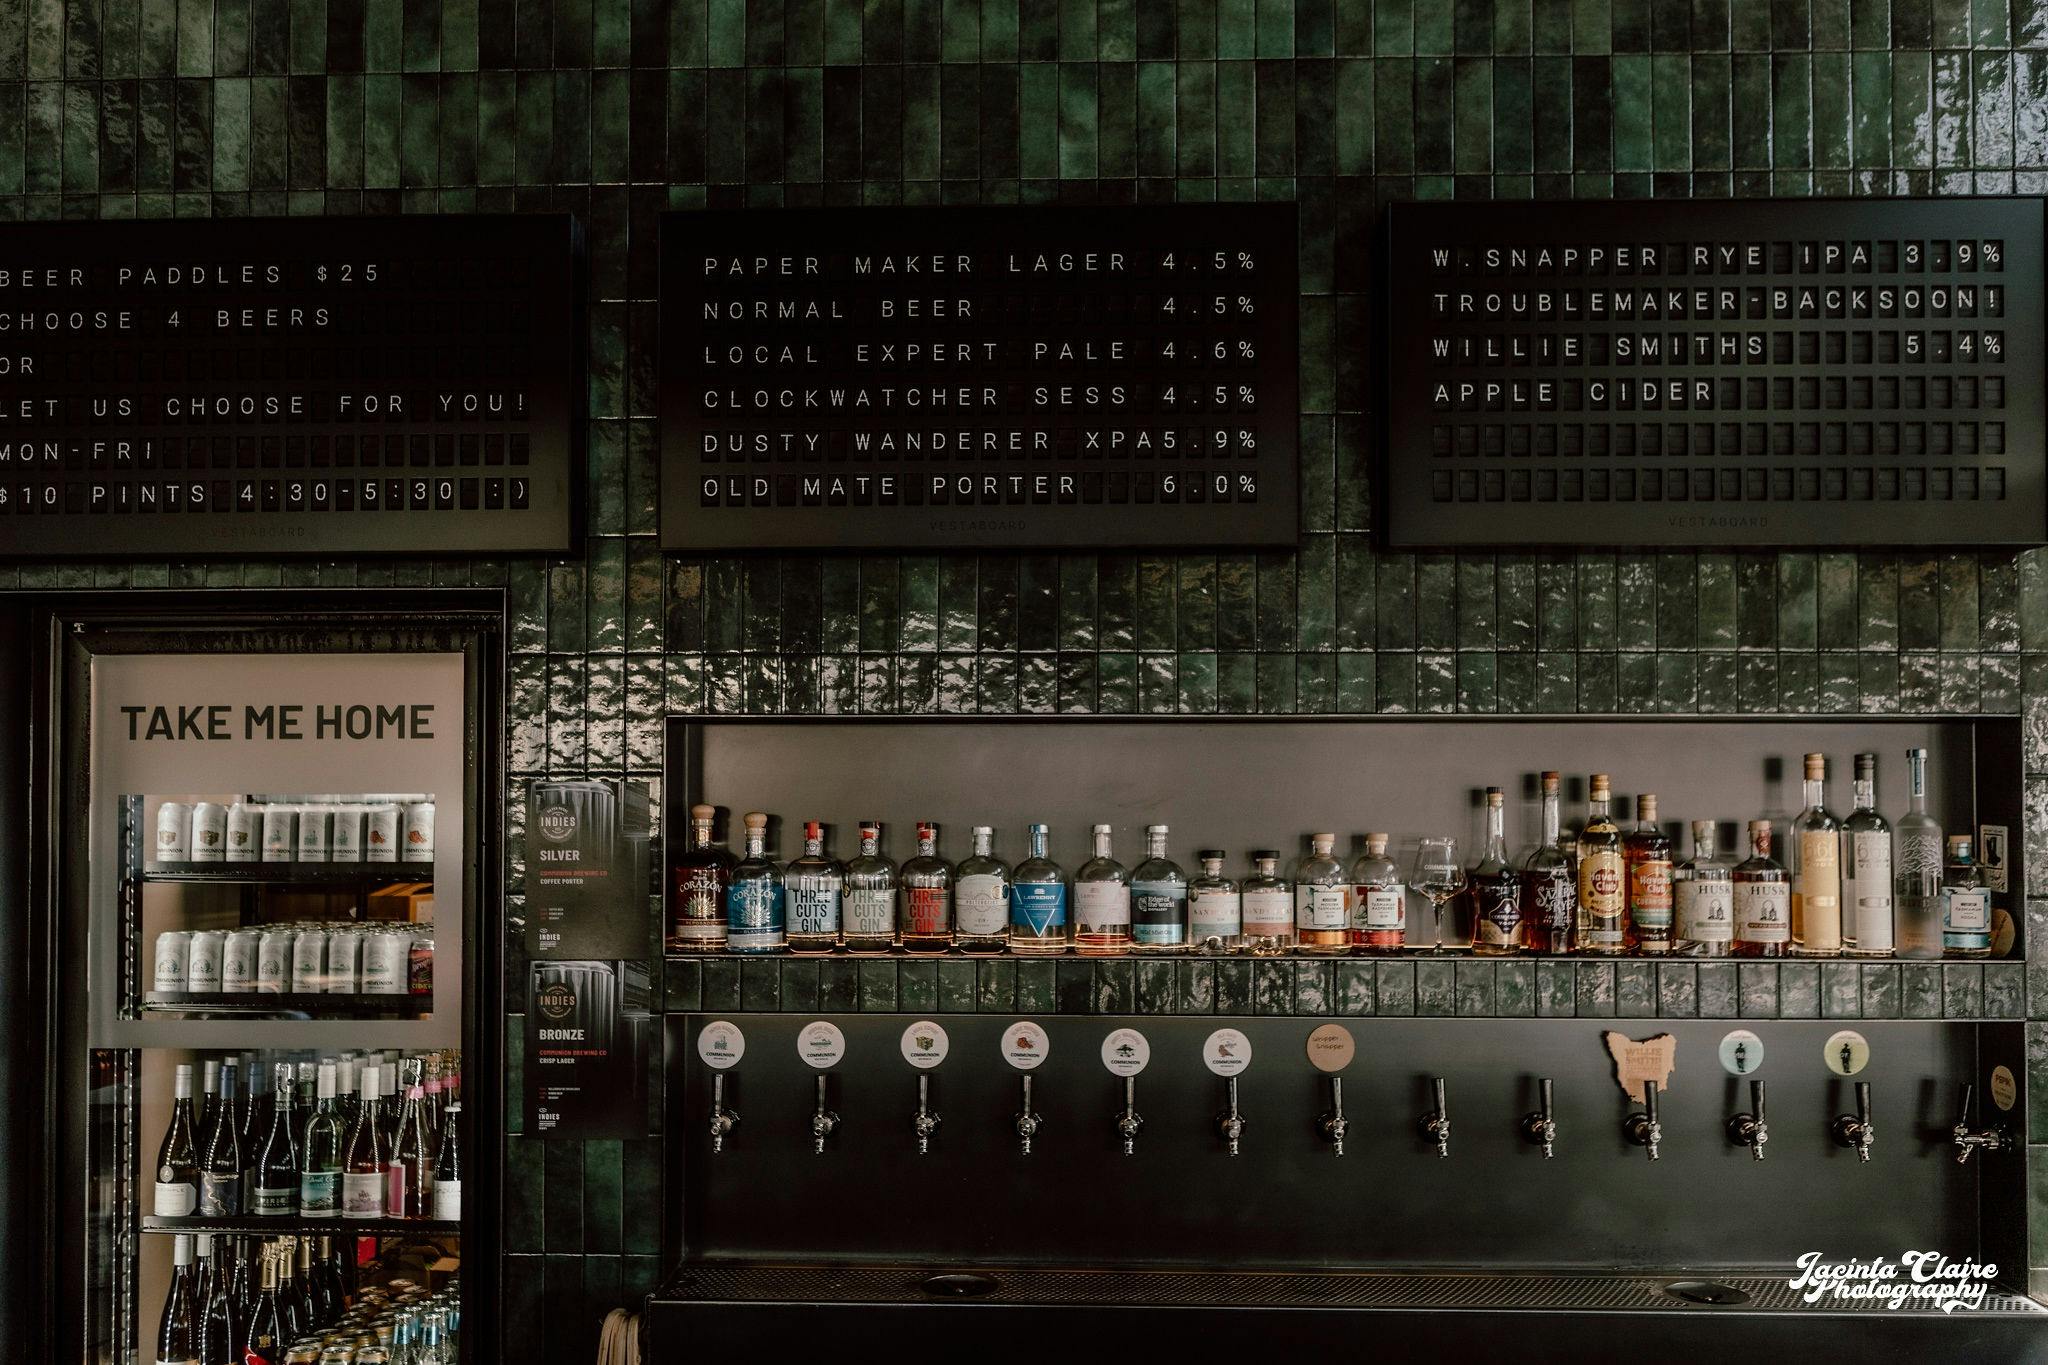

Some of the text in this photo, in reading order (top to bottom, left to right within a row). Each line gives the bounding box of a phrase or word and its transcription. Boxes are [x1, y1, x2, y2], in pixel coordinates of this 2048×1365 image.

[1694, 246, 1761, 265] RYE
[1804, 245, 1867, 265] IPA
[1906, 244, 2000, 264] 3.9%
[705, 251, 1254, 275] PAPER MAKER LAGER 4.5%
[0, 264, 377, 287] BEER PADDLES $25
[704, 296, 1254, 320] NORMAL BEER 4.5%
[1434, 289, 1995, 312] TROUBLEMAKER-BACKSOON!
[0, 308, 329, 331] CHOOSE 4 BEERS
[705, 340, 1255, 364] LOCAL EXPERT PALE 4.6%
[1433, 335, 2001, 357] WILLIE SMITHS 5.4%
[0, 356, 33, 374] OR
[704, 385, 1255, 408] CLOCKWATCHER SESS 4.5%
[1434, 381, 1710, 402] APPLE CIDER
[94, 398, 131, 417] US
[167, 396, 303, 416] CHOOSE
[340, 395, 402, 413] FOR
[439, 393, 523, 412] YOU!
[704, 433, 819, 453] DUSTY
[855, 431, 1048, 451] WANDERER
[92, 484, 204, 504] PINTS
[240, 482, 452, 502] 4:30-5:30
[704, 475, 1256, 497] OLD MATE PORTER 6.0%
[928, 520, 1026, 531] VESTABOARD
[1668, 516, 1769, 528] VESTABOARD
[121, 704, 435, 741] TAKE ME HOME
[541, 816, 576, 827] INDIES
[539, 849, 580, 862] SILVER
[792, 889, 831, 904] THREE
[852, 889, 889, 904] THREE
[907, 889, 944, 904] THREE
[1699, 885, 1731, 894] HUSK
[1751, 886, 1785, 895] HUSK
[796, 904, 827, 918] CUTS
[854, 904, 886, 918] CUTS
[909, 904, 941, 918] CUTS
[801, 918, 823, 932] GIN
[859, 918, 881, 932] GIN
[915, 918, 936, 932] GIN
[540, 995, 576, 1006] INDIES
[539, 1029, 585, 1041] BRONZE
[1624, 1047, 1663, 1056] WILLIE
[538, 1113, 561, 1121] INDIES
